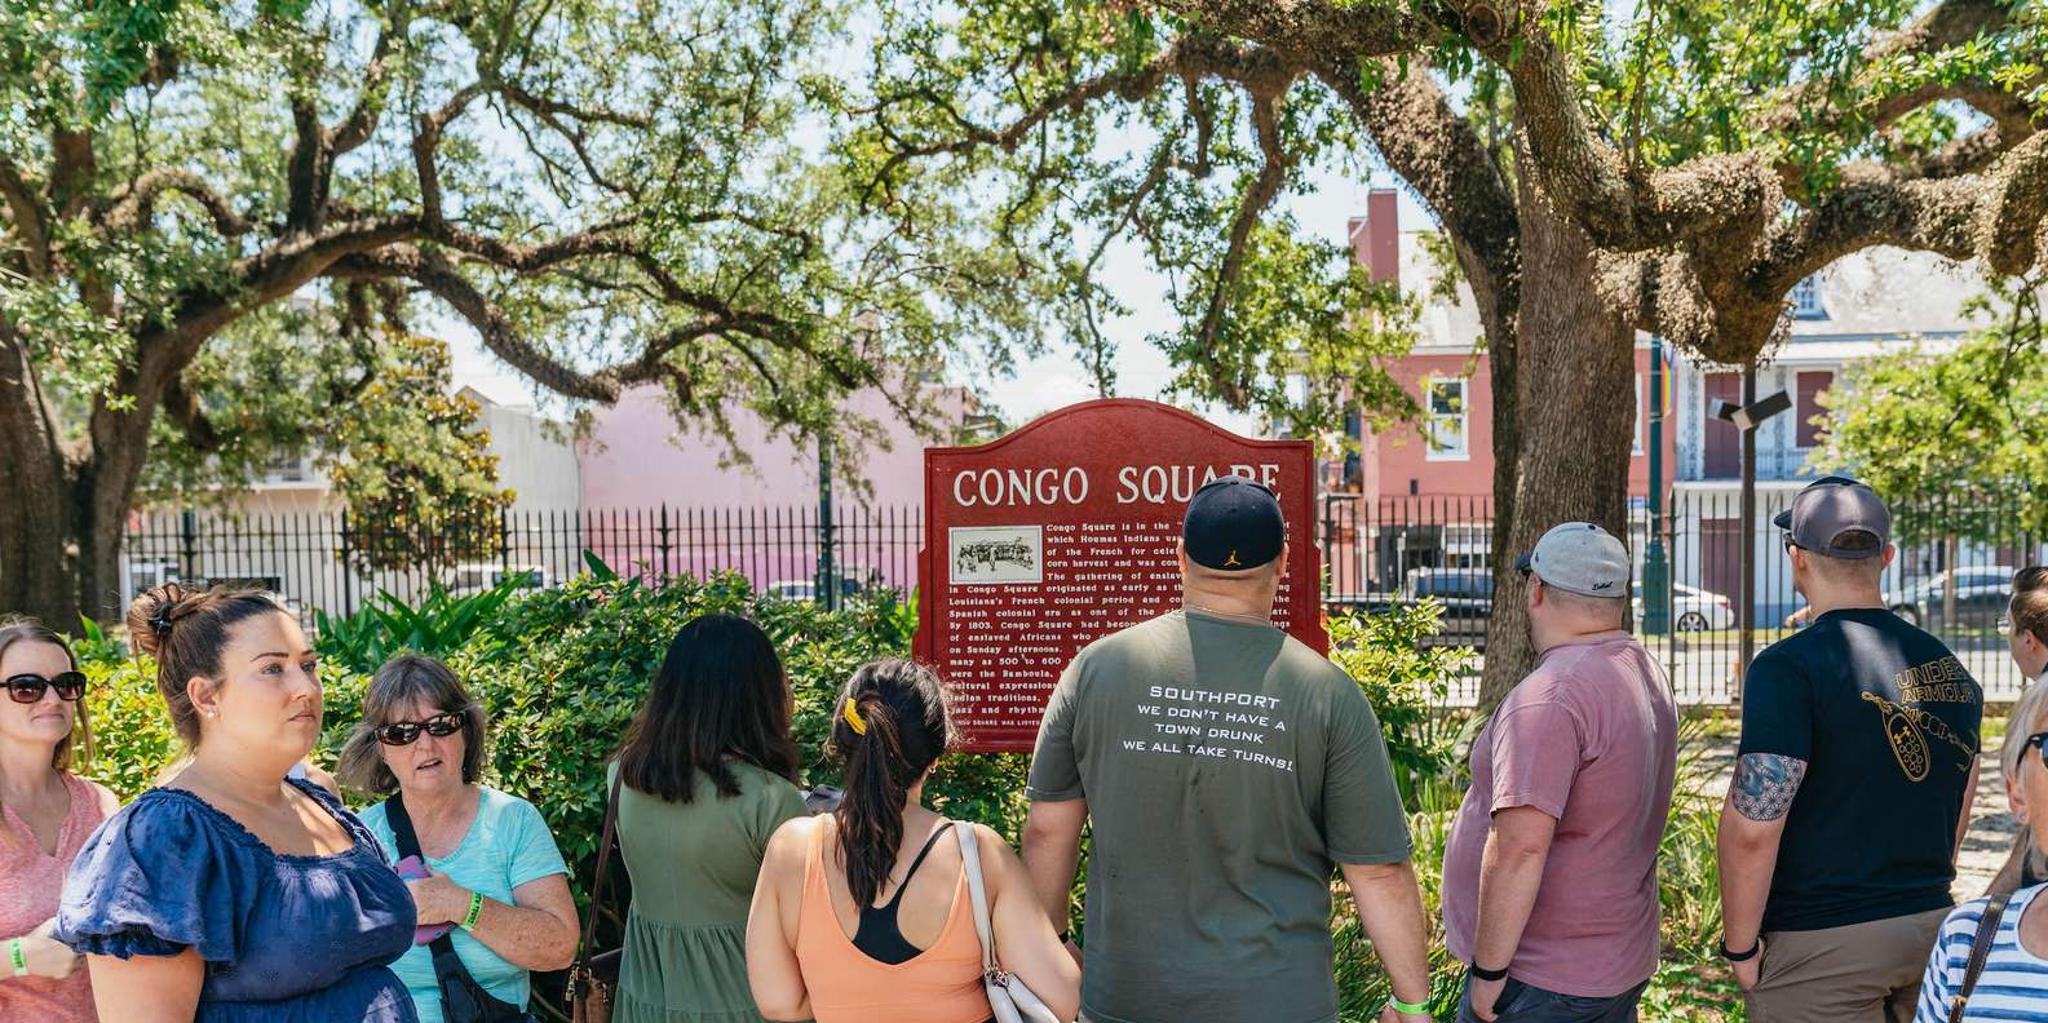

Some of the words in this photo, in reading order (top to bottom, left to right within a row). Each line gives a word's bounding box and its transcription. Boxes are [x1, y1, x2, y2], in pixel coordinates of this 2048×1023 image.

[953, 466, 1089, 507] CONGO
[1046, 524, 1075, 533] Congo
[1082, 523, 1115, 533] Square
[1154, 522, 1170, 530] the
[1047, 535, 1074, 543] which
[1047, 548, 1057, 556] of
[1066, 548, 1082, 556] the
[1131, 547, 1145, 555] for
[1075, 573, 1123, 582] gathering
[1131, 572, 1141, 580] of
[1150, 572, 1181, 580] enslav
[967, 584, 997, 594] Congo
[1004, 584, 1039, 594] Square
[1046, 584, 1097, 593] originated
[1122, 584, 1149, 592] early
[949, 597, 1002, 605] Louisiana's
[1012, 597, 1045, 605] French
[1054, 597, 1093, 605] colonial
[1102, 596, 1134, 605] period
[949, 610, 987, 618] Spanish
[996, 609, 1035, 617] colonial
[1118, 608, 1128, 616] of
[949, 622, 961, 631] By
[1001, 622, 1030, 630] Congo
[1038, 621, 1072, 630] Square
[1081, 620, 1099, 628] had
[968, 633, 1010, 641] enslaved
[1020, 633, 1061, 641] Africans
[967, 646, 1002, 654] Sunday
[949, 659, 974, 667] many
[1042, 657, 1061, 665] 600
[980, 670, 995, 678] the
[1150, 686, 1280, 710] SOUTHPORT
[982, 706, 999, 714] and
[1138, 704, 1161, 716] WE
[1167, 707, 1219, 721] DON'T
[1225, 712, 1269, 727] HAVE
[1274, 720, 1286, 732] A
[1155, 723, 1200, 735] TOWN
[1208, 728, 1264, 745] DRUNK
[1123, 740, 1146, 751] WE
[1151, 742, 1180, 753] ALL
[1187, 744, 1227, 758] TAKE
[1233, 749, 1293, 772] TURNS!
